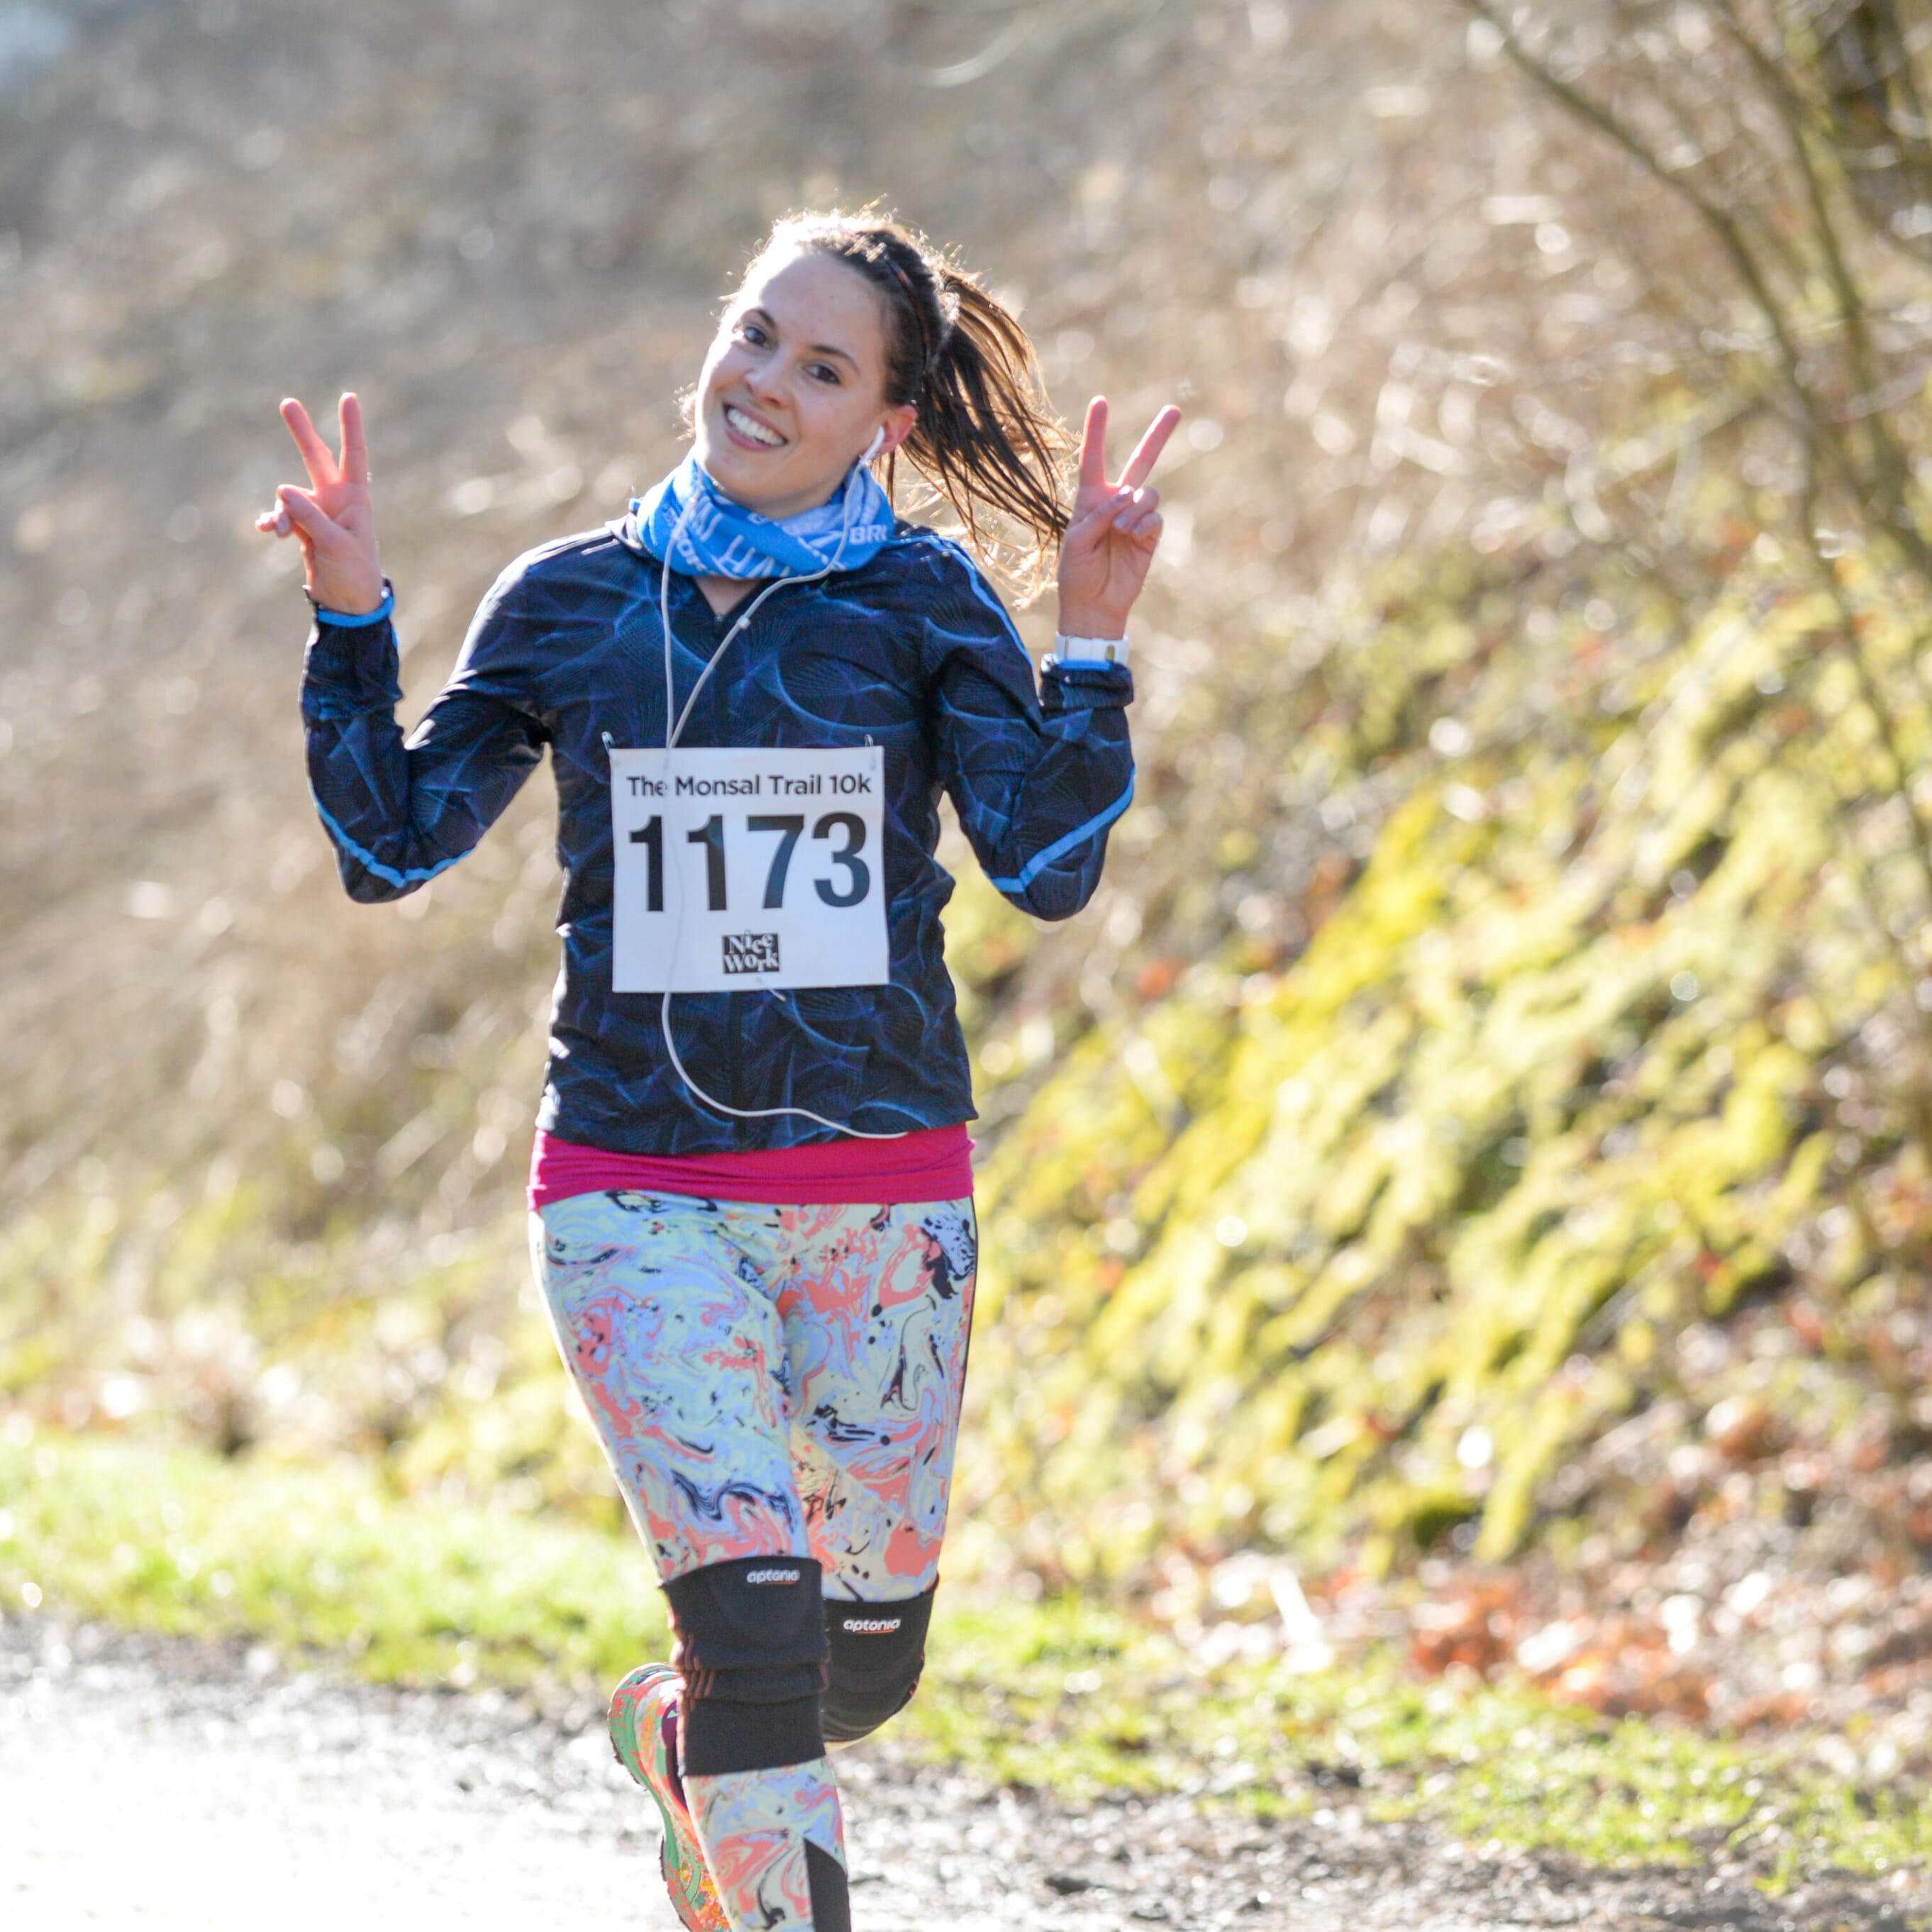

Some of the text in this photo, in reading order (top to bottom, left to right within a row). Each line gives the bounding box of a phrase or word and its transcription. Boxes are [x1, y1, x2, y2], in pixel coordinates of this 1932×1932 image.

[626, 772, 872, 796] The Monsal Trail 10k
[628, 811, 871, 912] 1173
[728, 929, 774, 954] Nice
[723, 948, 779, 972] Work
[747, 1569, 800, 1584] aptonia
[843, 1619, 901, 1631] aptonia
